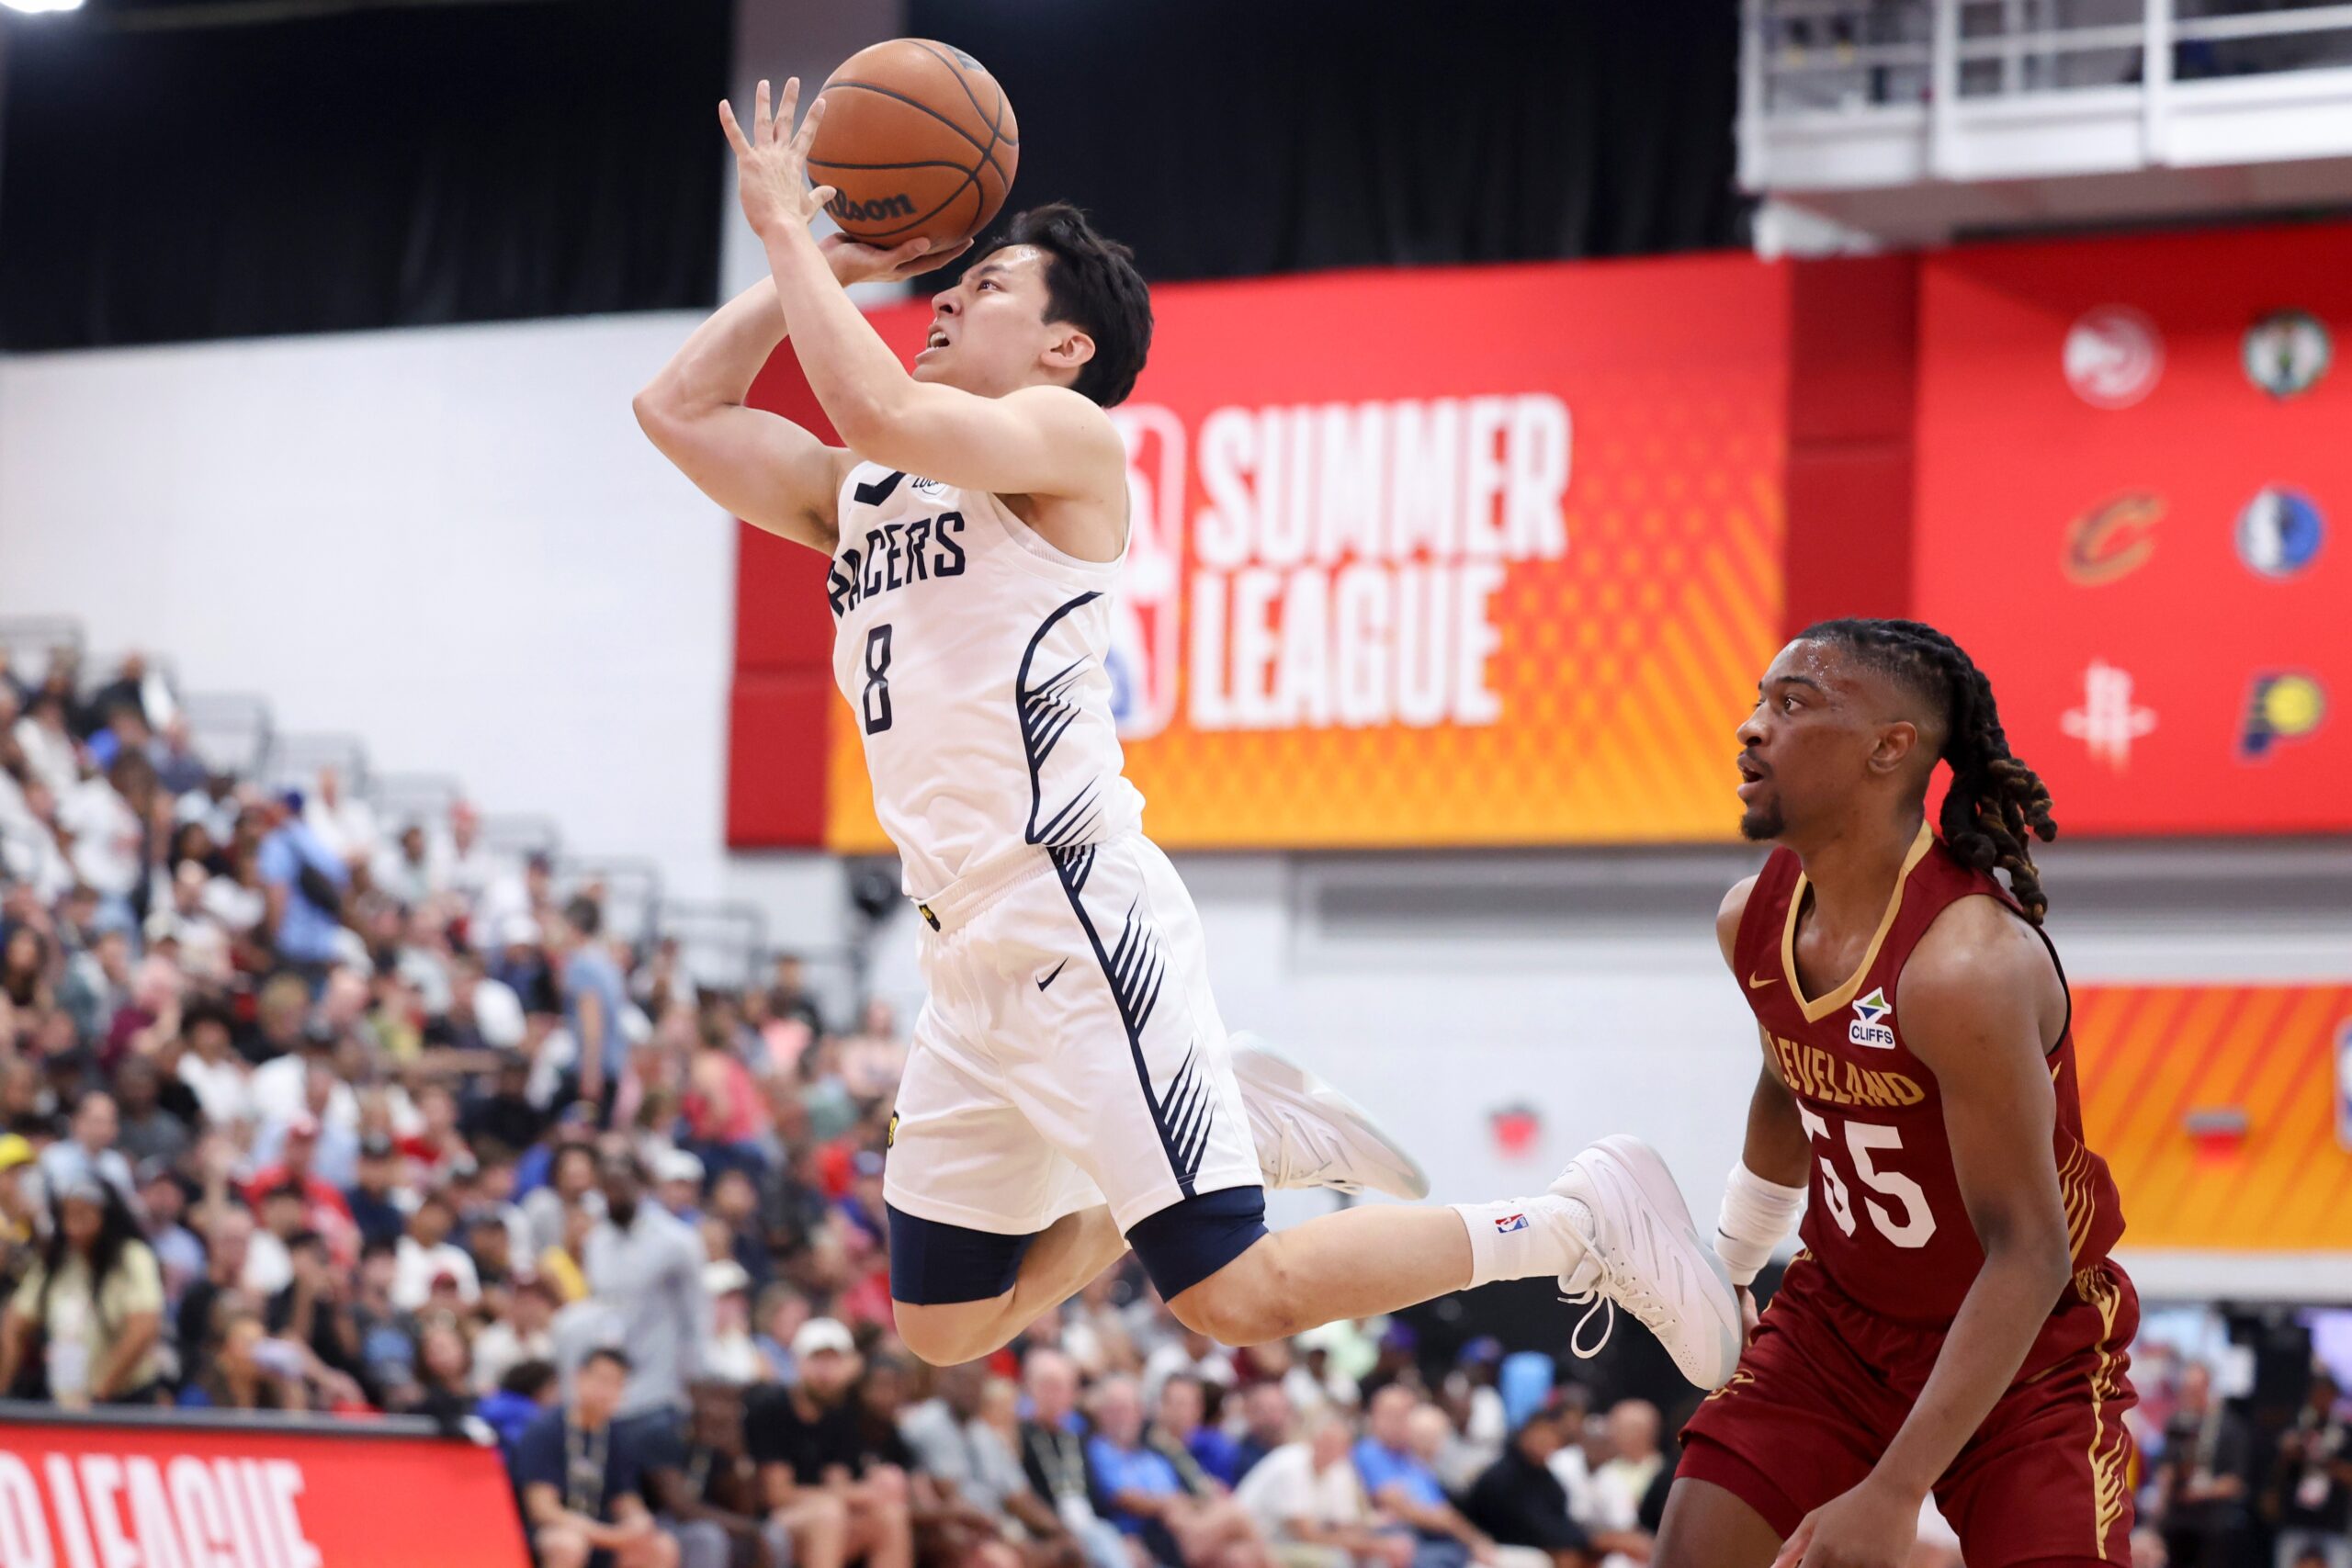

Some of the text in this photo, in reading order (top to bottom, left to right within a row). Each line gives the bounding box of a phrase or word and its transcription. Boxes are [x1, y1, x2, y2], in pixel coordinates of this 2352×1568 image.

[1197, 394, 1572, 571] SUMMER
[827, 512, 965, 618] PACERS
[863, 624, 892, 736] 8
[1190, 562, 1507, 728] LEAGUE
[1766, 1031, 1926, 1107] EVELAND
[1851, 1024, 1894, 1045] CLIFFS
[1795, 1097, 1938, 1248] 55
